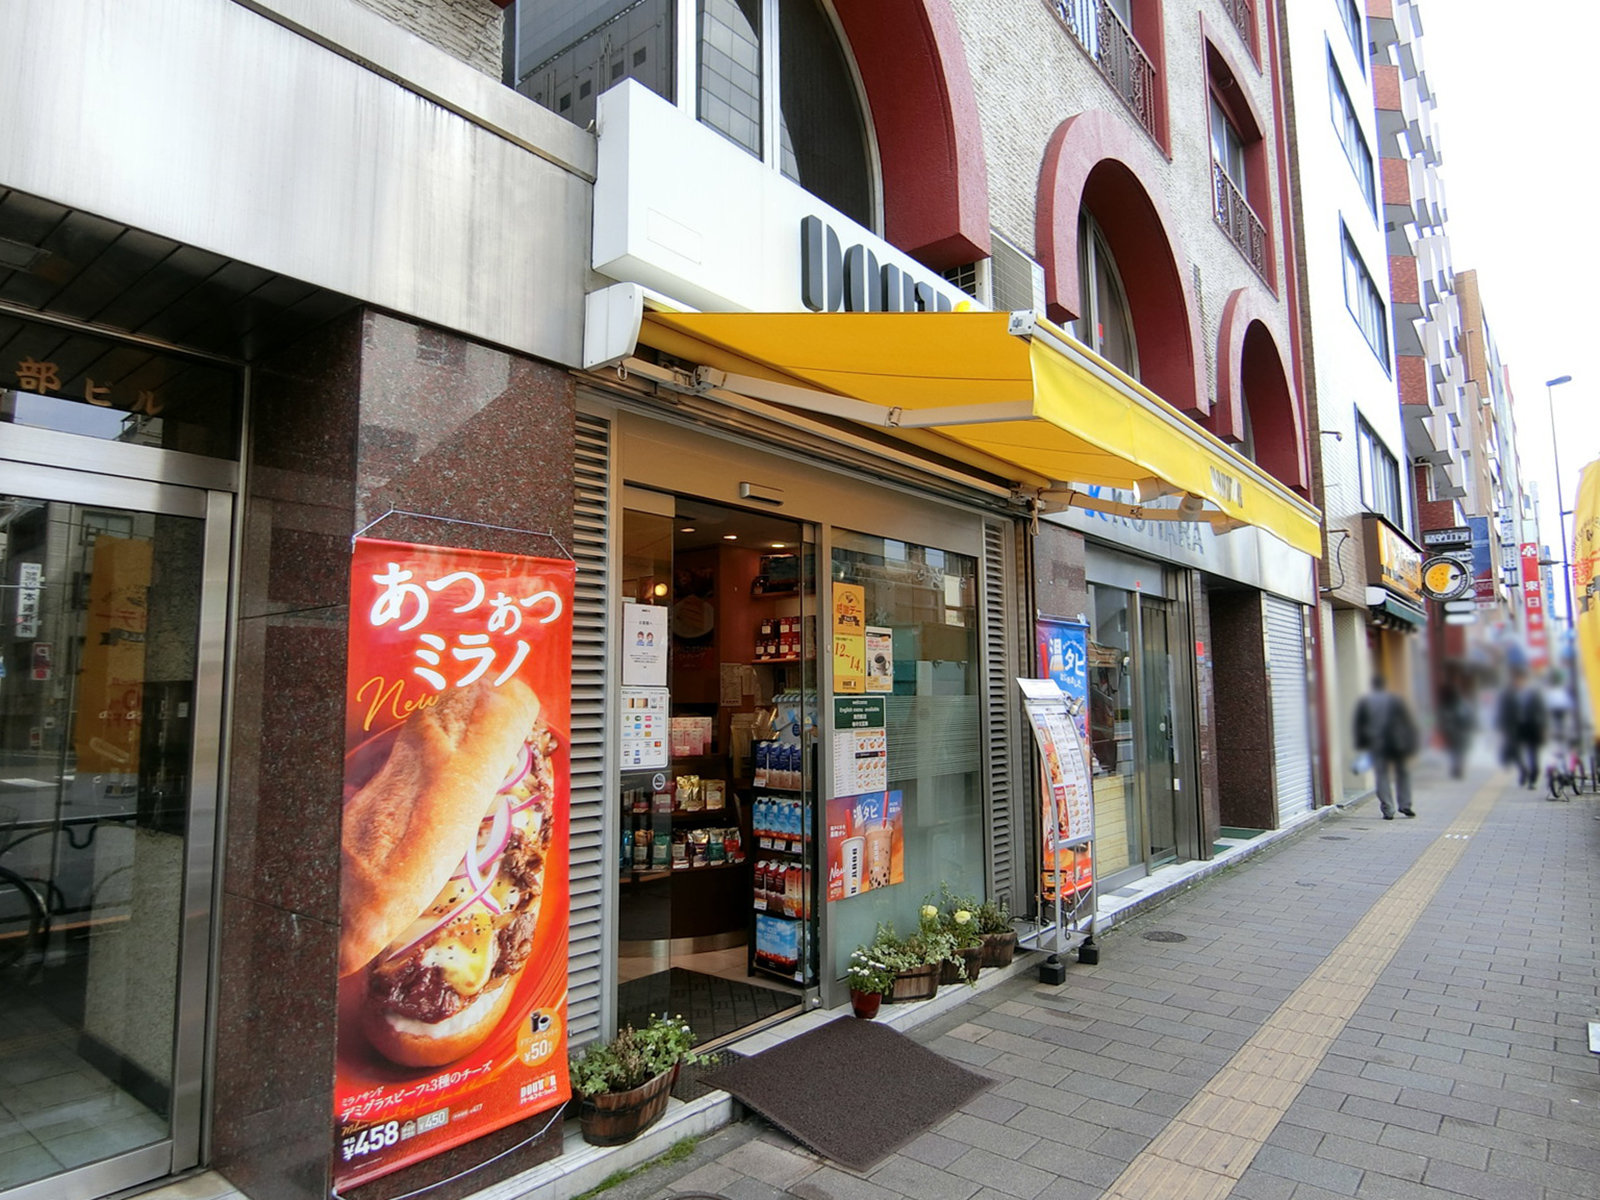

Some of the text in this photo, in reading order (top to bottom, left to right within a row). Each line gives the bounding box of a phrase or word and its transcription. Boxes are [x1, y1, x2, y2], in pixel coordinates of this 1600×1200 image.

[15, 356, 164, 415] 部ビル
[370, 562, 563, 635] あつあつ
[413, 633, 531, 690] ミラノ
[356, 676, 440, 732] New
[341, 1060, 493, 1122] デミグラスビーフと3種のチーズ
[341, 1086, 385, 1107] ミラノサンド
[342, 1120, 400, 1161] ¥458
[418, 1111, 447, 1131] ¥450
